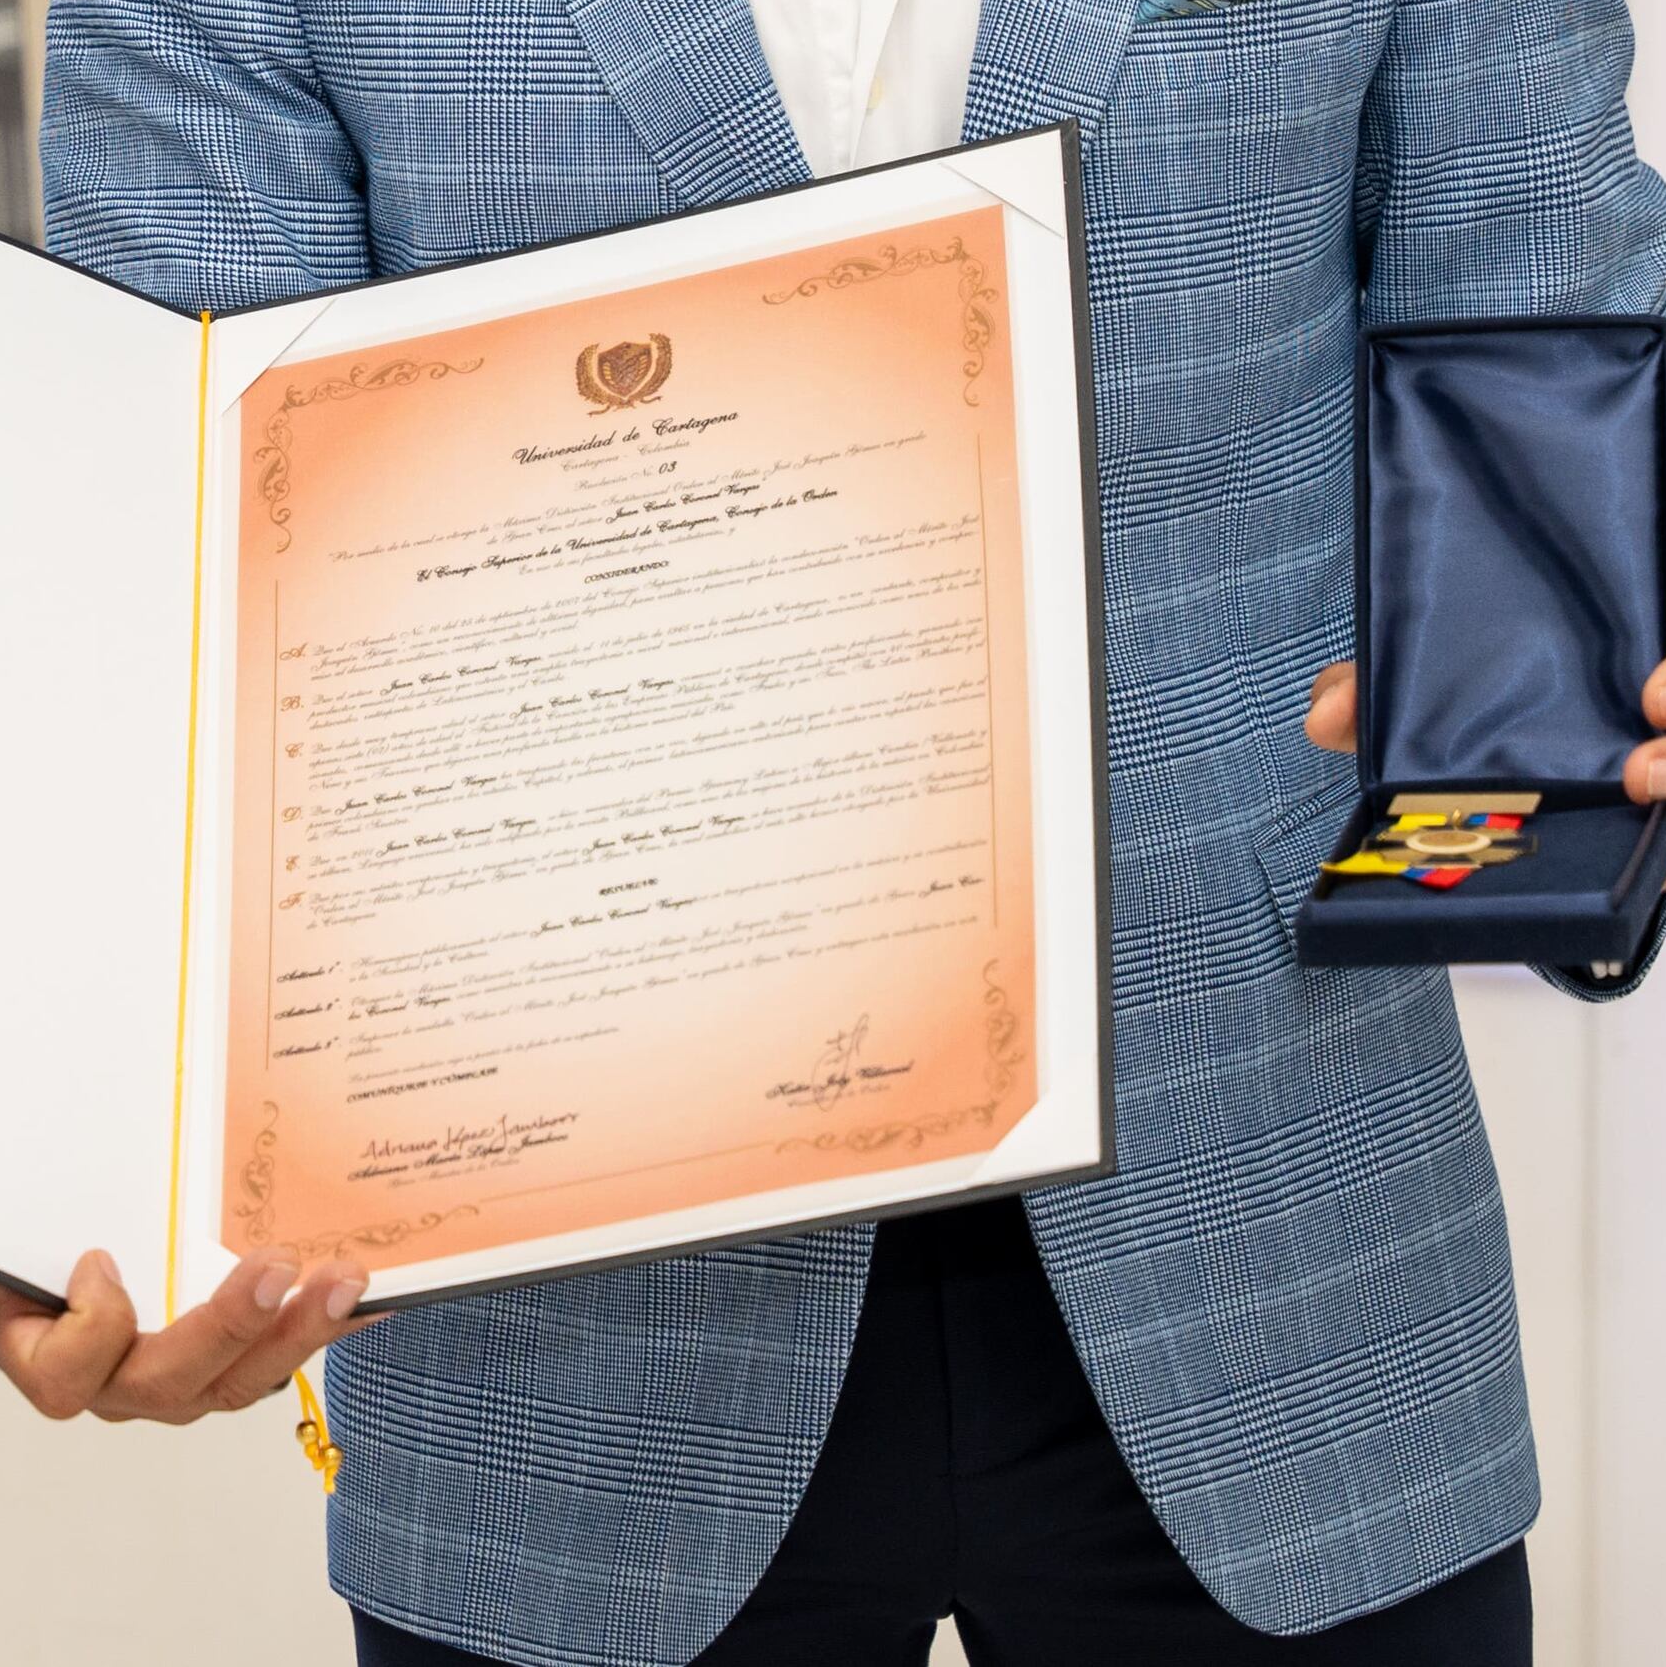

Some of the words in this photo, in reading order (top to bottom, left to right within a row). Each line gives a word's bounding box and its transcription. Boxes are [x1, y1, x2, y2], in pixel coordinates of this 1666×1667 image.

[511, 429, 617, 465] Universidad
[621, 425, 640, 443] de
[651, 411, 738, 436] Cartagena
[559, 454, 619, 472] Cartagena
[636, 438, 690, 456] Colombia
[657, 460, 677, 474] 03
[605, 507, 639, 524] Juan
[642, 498, 676, 512] Carlos
[679, 487, 723, 505] Coronel
[416, 568, 432, 582] El
[433, 563, 477, 578] Consejo
[480, 553, 533, 569] Superior
[534, 546, 548, 558] de
[549, 543, 562, 555] la
[565, 526, 638, 551] Universidad
[638, 524, 652, 537] de
[724, 503, 768, 518] Consejo
[770, 497, 784, 509] de
[785, 494, 797, 506] la
[800, 487, 838, 502] Orden
[379, 678, 413, 696] Juan
[417, 670, 452, 685] Carlos
[456, 660, 499, 677] Coronel
[508, 702, 543, 719] Juan
[548, 693, 582, 708] Carlos
[587, 683, 631, 700] Coronel
[334, 799, 368, 815] Juan
[373, 790, 407, 805] Carlos
[411, 779, 455, 797] Coronel
[375, 840, 409, 858] Juan
[413, 832, 447, 847] Carlos
[451, 822, 495, 839] Coronel
[581, 837, 616, 855] Juan
[620, 830, 654, 844] Carlos
[659, 819, 702, 837] Coronel
[918, 881, 954, 898] Juan
[529, 920, 564, 938] Juan
[568, 913, 603, 927] Carlos
[607, 903, 651, 920] Coronel
[364, 1000, 409, 1017] Coronel
